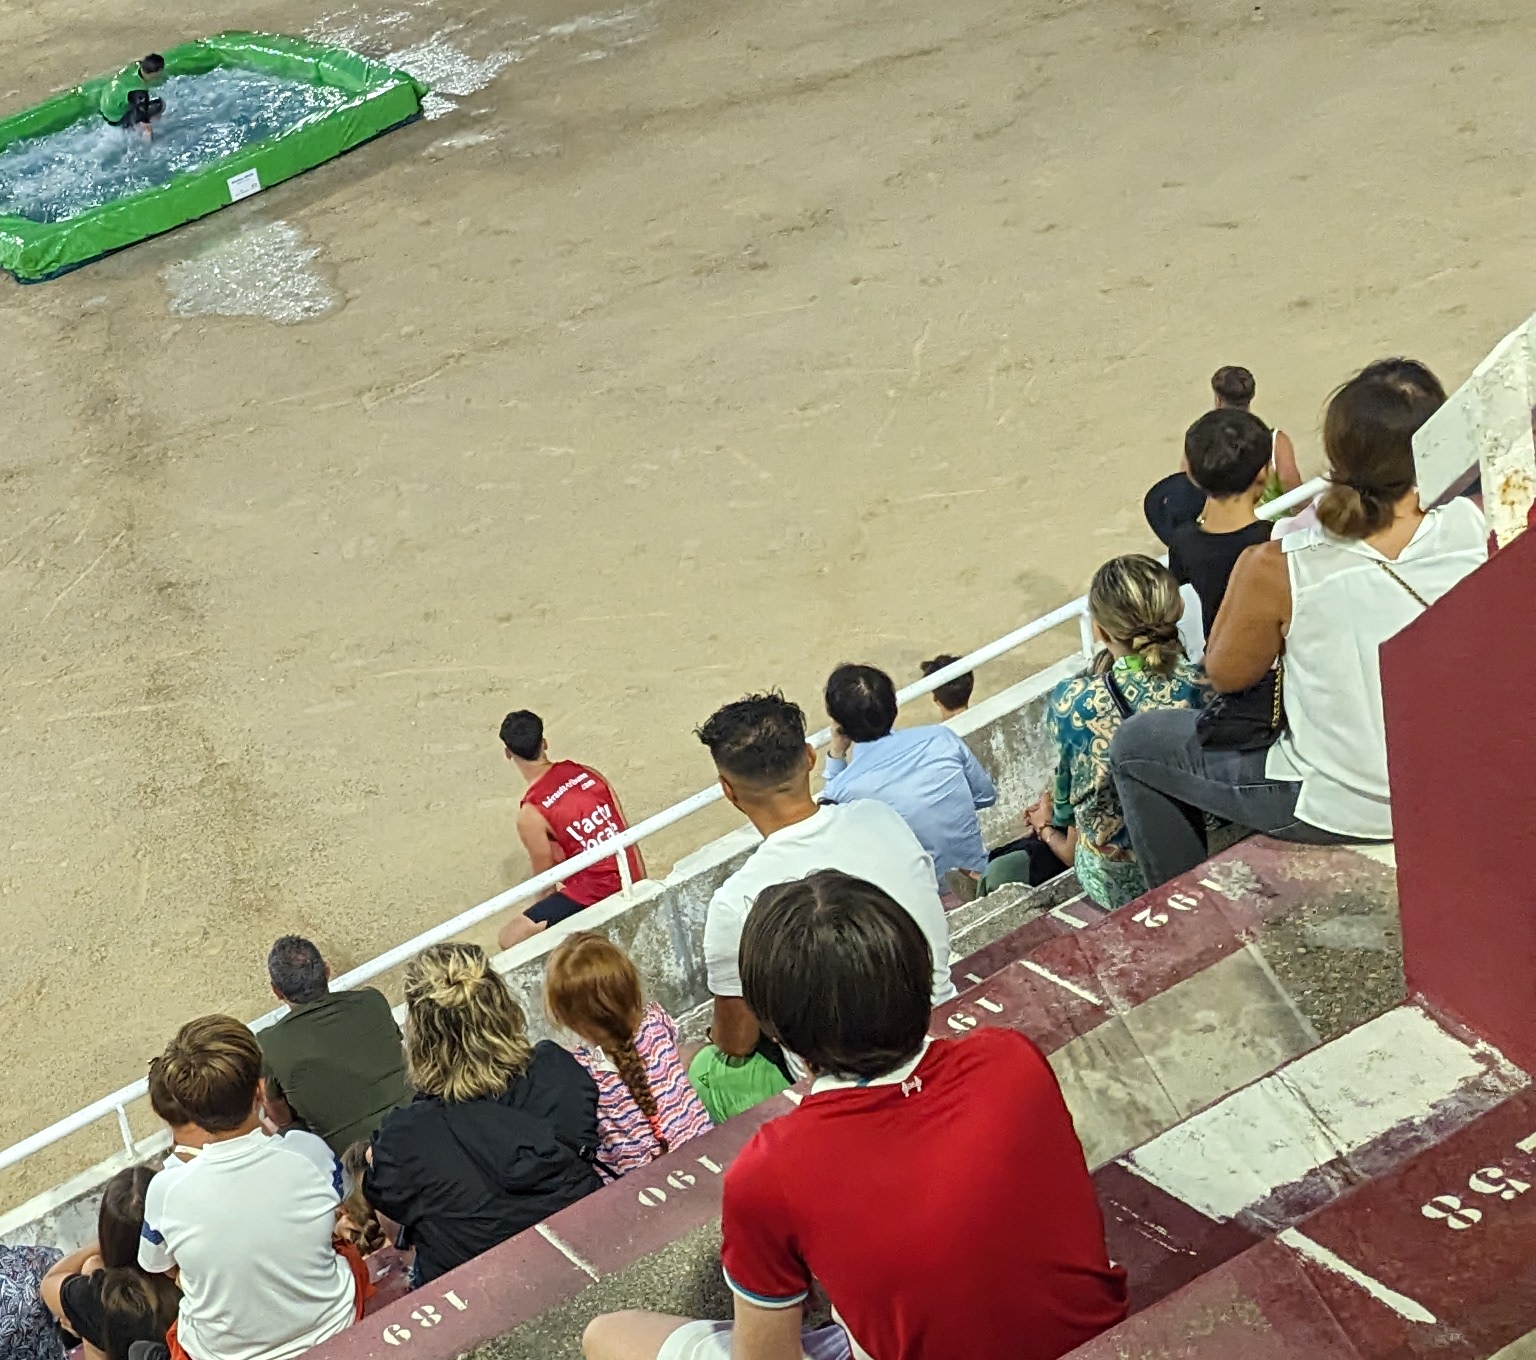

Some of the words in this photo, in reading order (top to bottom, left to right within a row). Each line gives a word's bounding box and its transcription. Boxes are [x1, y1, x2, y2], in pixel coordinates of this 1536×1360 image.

[947, 996, 1004, 1034] 19
[637, 1154, 724, 1208] 190
[382, 1289, 470, 1346] 189
